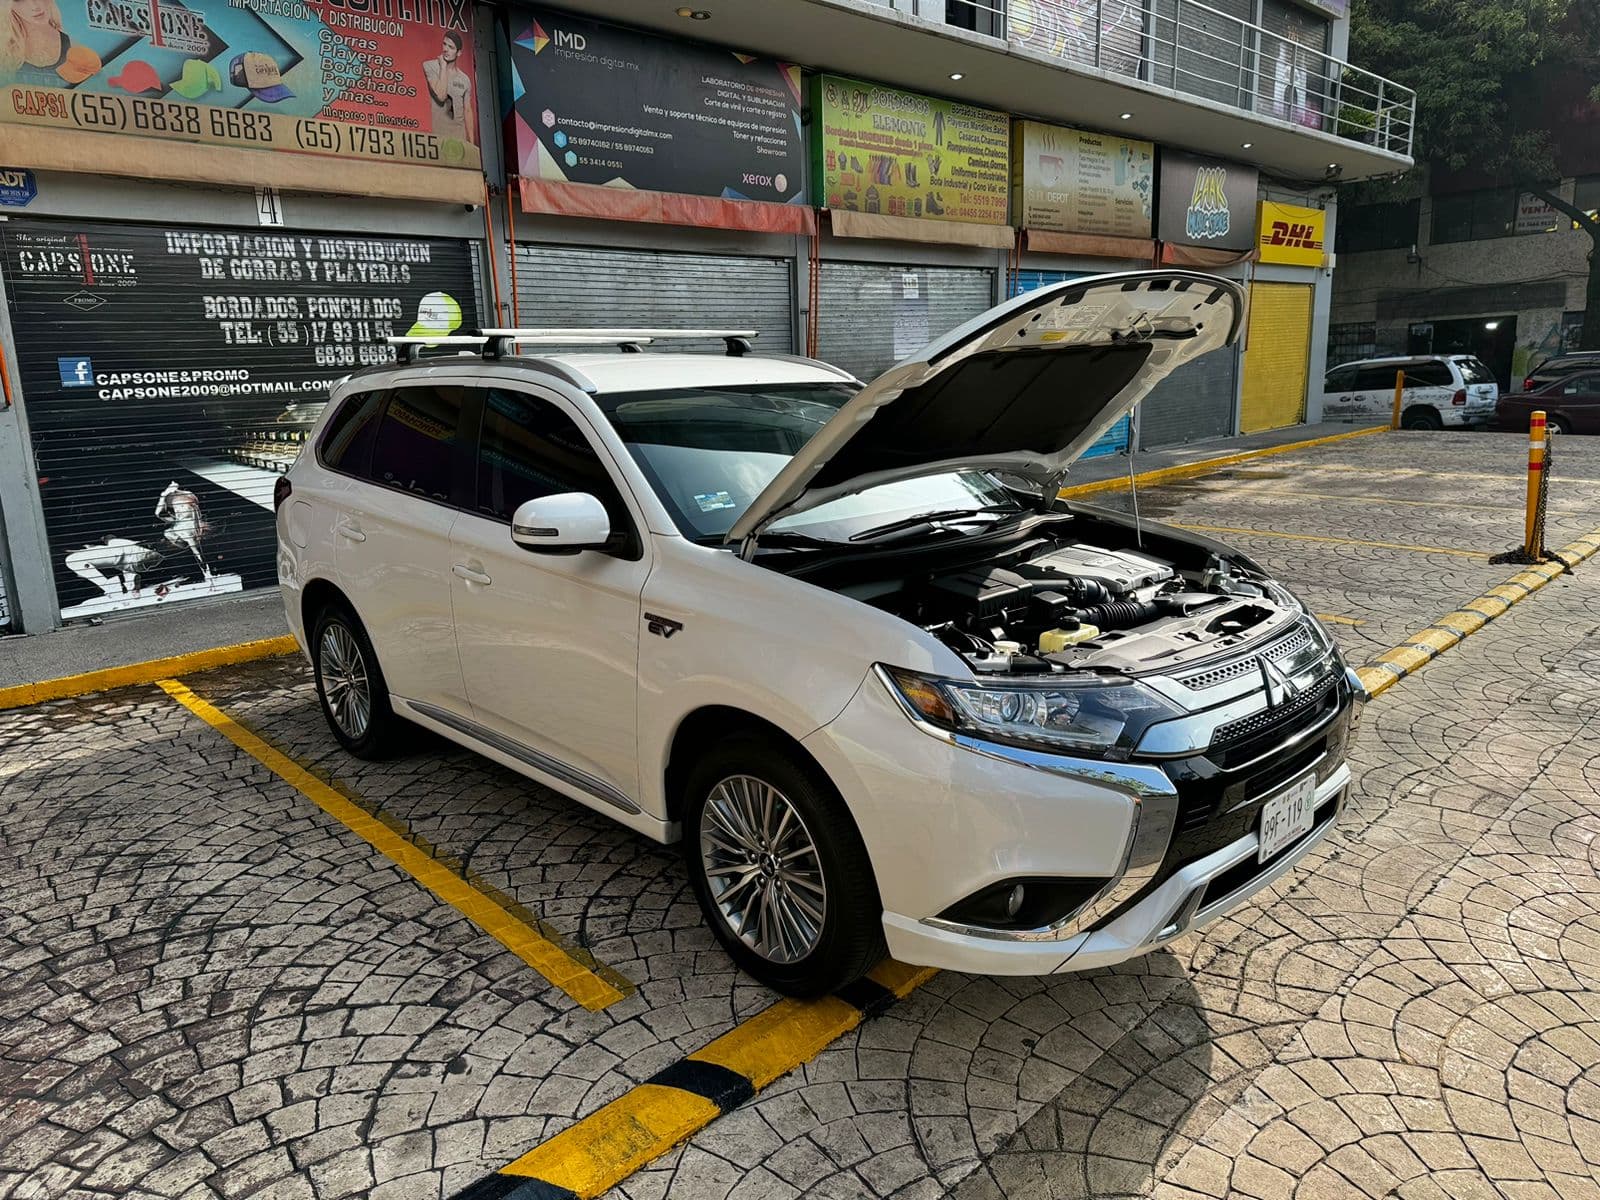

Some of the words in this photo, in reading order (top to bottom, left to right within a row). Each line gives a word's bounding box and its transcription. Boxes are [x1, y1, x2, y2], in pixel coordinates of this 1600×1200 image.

[315, 10, 325, 23] Y
[329, 11, 404, 37] DISTRIBUCIÓN
[187, 44, 206, 54] 2009
[318, 29, 378, 51] Gorras
[554, 29, 586, 50] IMD
[320, 43, 393, 67] Playeras
[600, 56, 625, 69] digital
[626, 62, 640, 71] mx
[320, 57, 404, 82] Bordados
[322, 71, 417, 97] Ponchados
[701, 76, 745, 91] LABORATORIO
[746, 83, 754, 92] DE
[323, 88, 334, 101] y
[717, 90, 741, 101] DIGITAL
[704, 98, 721, 107] Corte
[722, 100, 729, 108] de
[730, 102, 741, 111] vinil
[746, 105, 761, 115] corte
[766, 109, 787, 119] registro
[12, 89, 68, 118] CAPS1
[71, 93, 127, 129] (55)
[133, 99, 201, 134] 6838
[210, 109, 273, 141] 6683
[295, 120, 341, 152] (55)
[349, 126, 394, 155] 1793
[402, 132, 439, 160] 1155
[368, 115, 375, 124] y
[558, 117, 673, 139] contacto@impresiondigitalmx.com
[643, 104, 664, 115] Venta
[664, 109, 668, 117] y
[670, 110, 695, 121] soporte
[695, 112, 717, 123] técnico
[718, 117, 726, 125] de
[727, 120, 751, 130] equipos
[751, 122, 758, 130] de
[760, 124, 787, 135] impresión
[568, 136, 578, 145] 55
[614, 142, 624, 151] 55
[733, 131, 749, 140] Toner
[754, 135, 787, 147] refacciones
[580, 157, 589, 165] 55
[756, 146, 787, 157] Showroom
[742, 172, 772, 187] xerox
[930, 176, 942, 186] Bota
[973, 181, 986, 191] Cono
[1047, 192, 1069, 204] DEPOT
[36, 236, 66, 245] original
[1271, 222, 1316, 249] DHL
[165, 232, 296, 258] IMPORTACION
[301, 239, 312, 259] Y
[318, 239, 431, 263] DISTRIBUCION
[199, 258, 226, 279] DE
[230, 259, 302, 280] GORRAS
[306, 261, 318, 281] Y
[324, 262, 411, 284] PLAYERAS
[307, 297, 402, 319] PONCHADOS
[220, 321, 262, 344] TEL:
[332, 322, 353, 342] 93
[357, 322, 371, 342] 11
[315, 345, 355, 366] 6838
[359, 345, 397, 365] 6683
[96, 370, 249, 386] CAPSONE&PROMO
[99, 380, 334, 400] CAPSONE2009@HOTMAIL.COM
